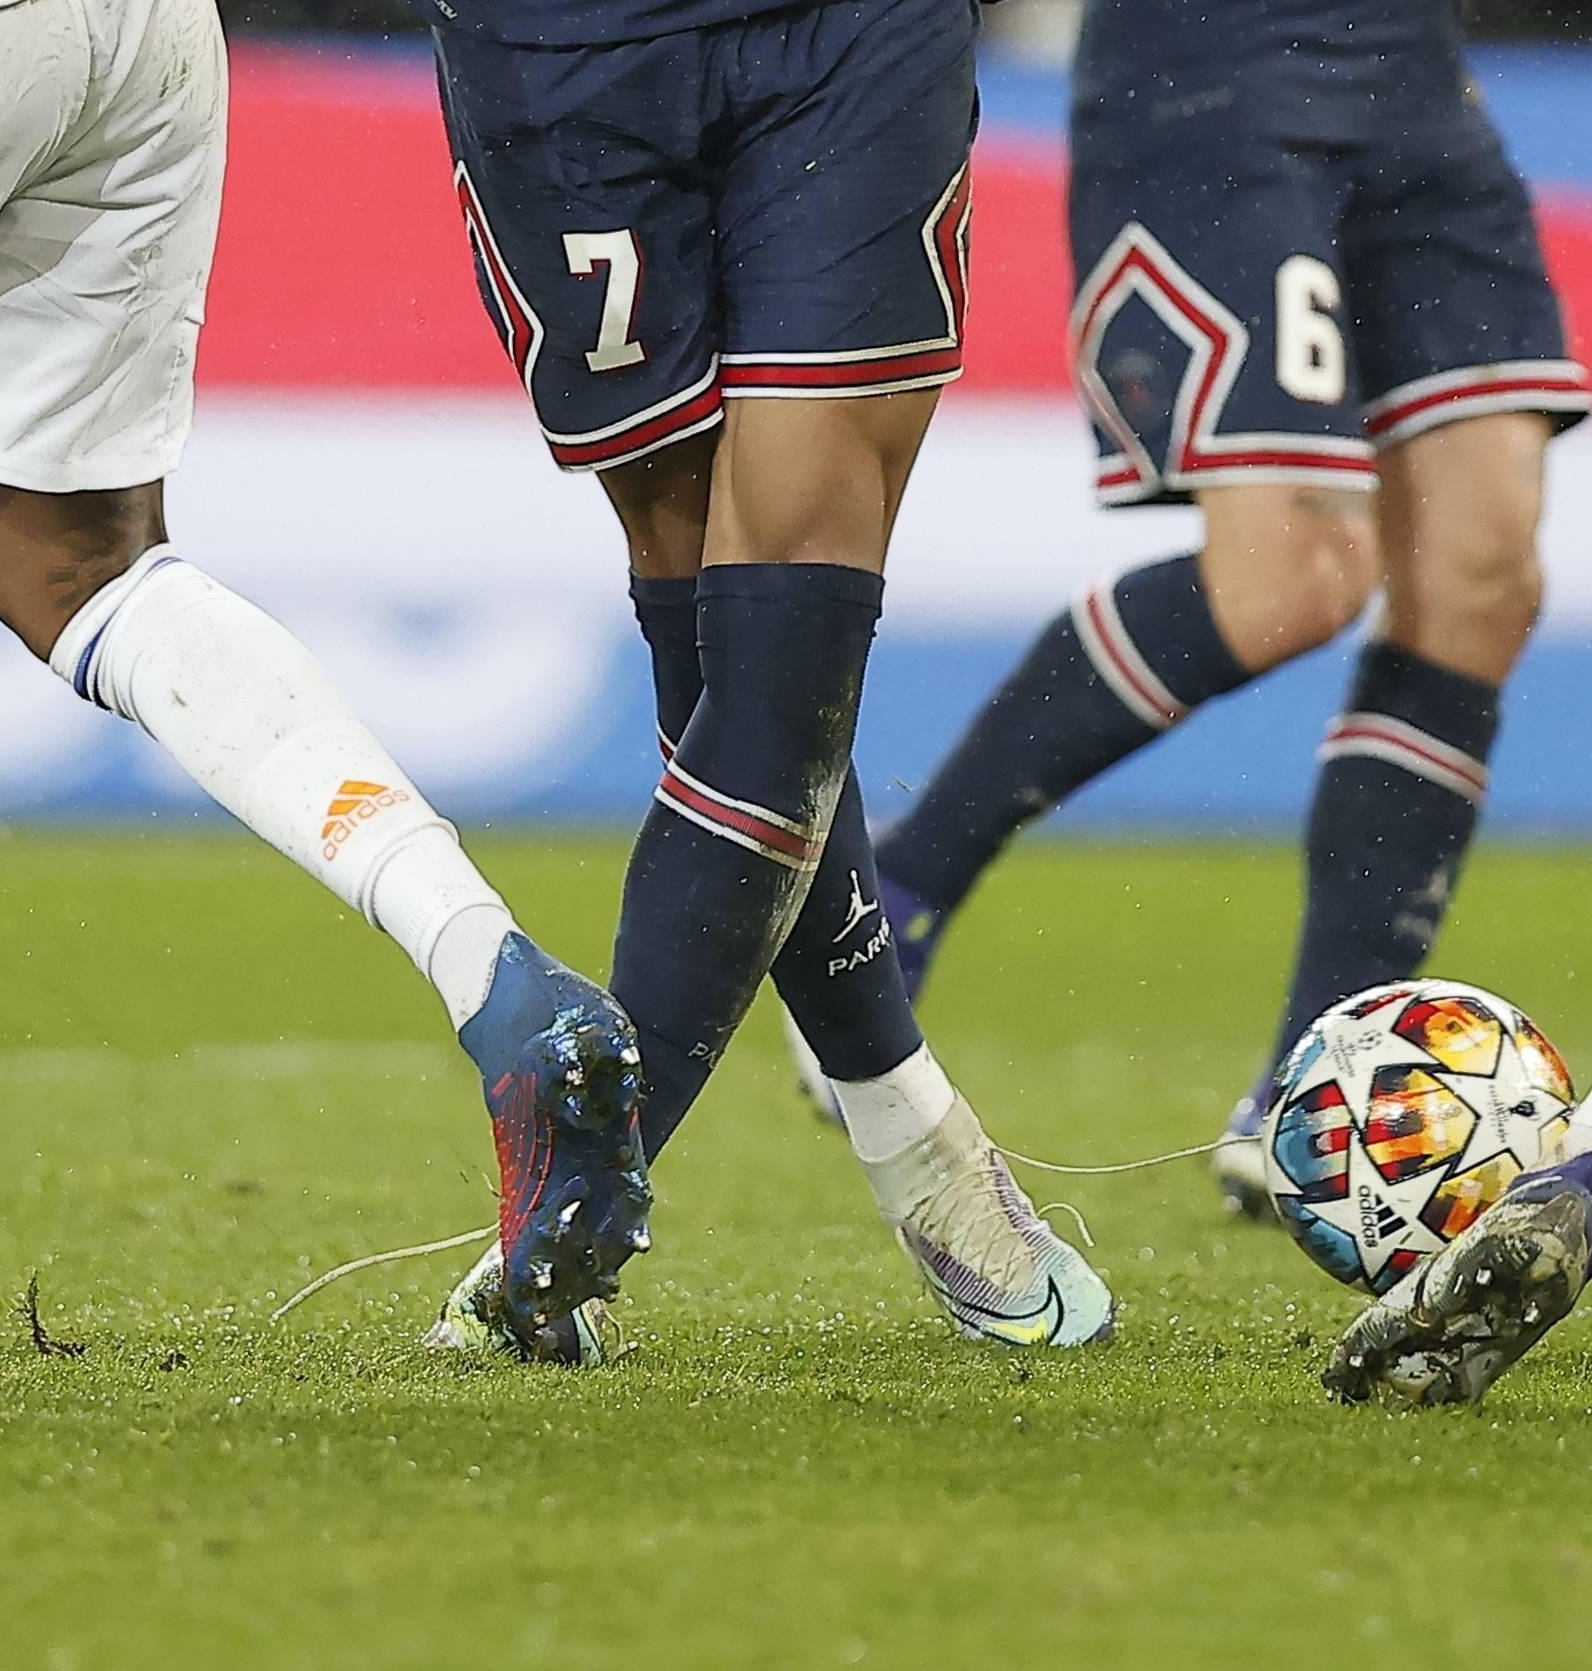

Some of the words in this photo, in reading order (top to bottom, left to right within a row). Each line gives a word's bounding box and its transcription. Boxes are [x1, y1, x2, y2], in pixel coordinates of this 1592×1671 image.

[562, 228, 647, 373] 7
[1274, 253, 1346, 406] 6
[323, 789, 410, 862] adidas
[1357, 1184, 1379, 1248] adidas
